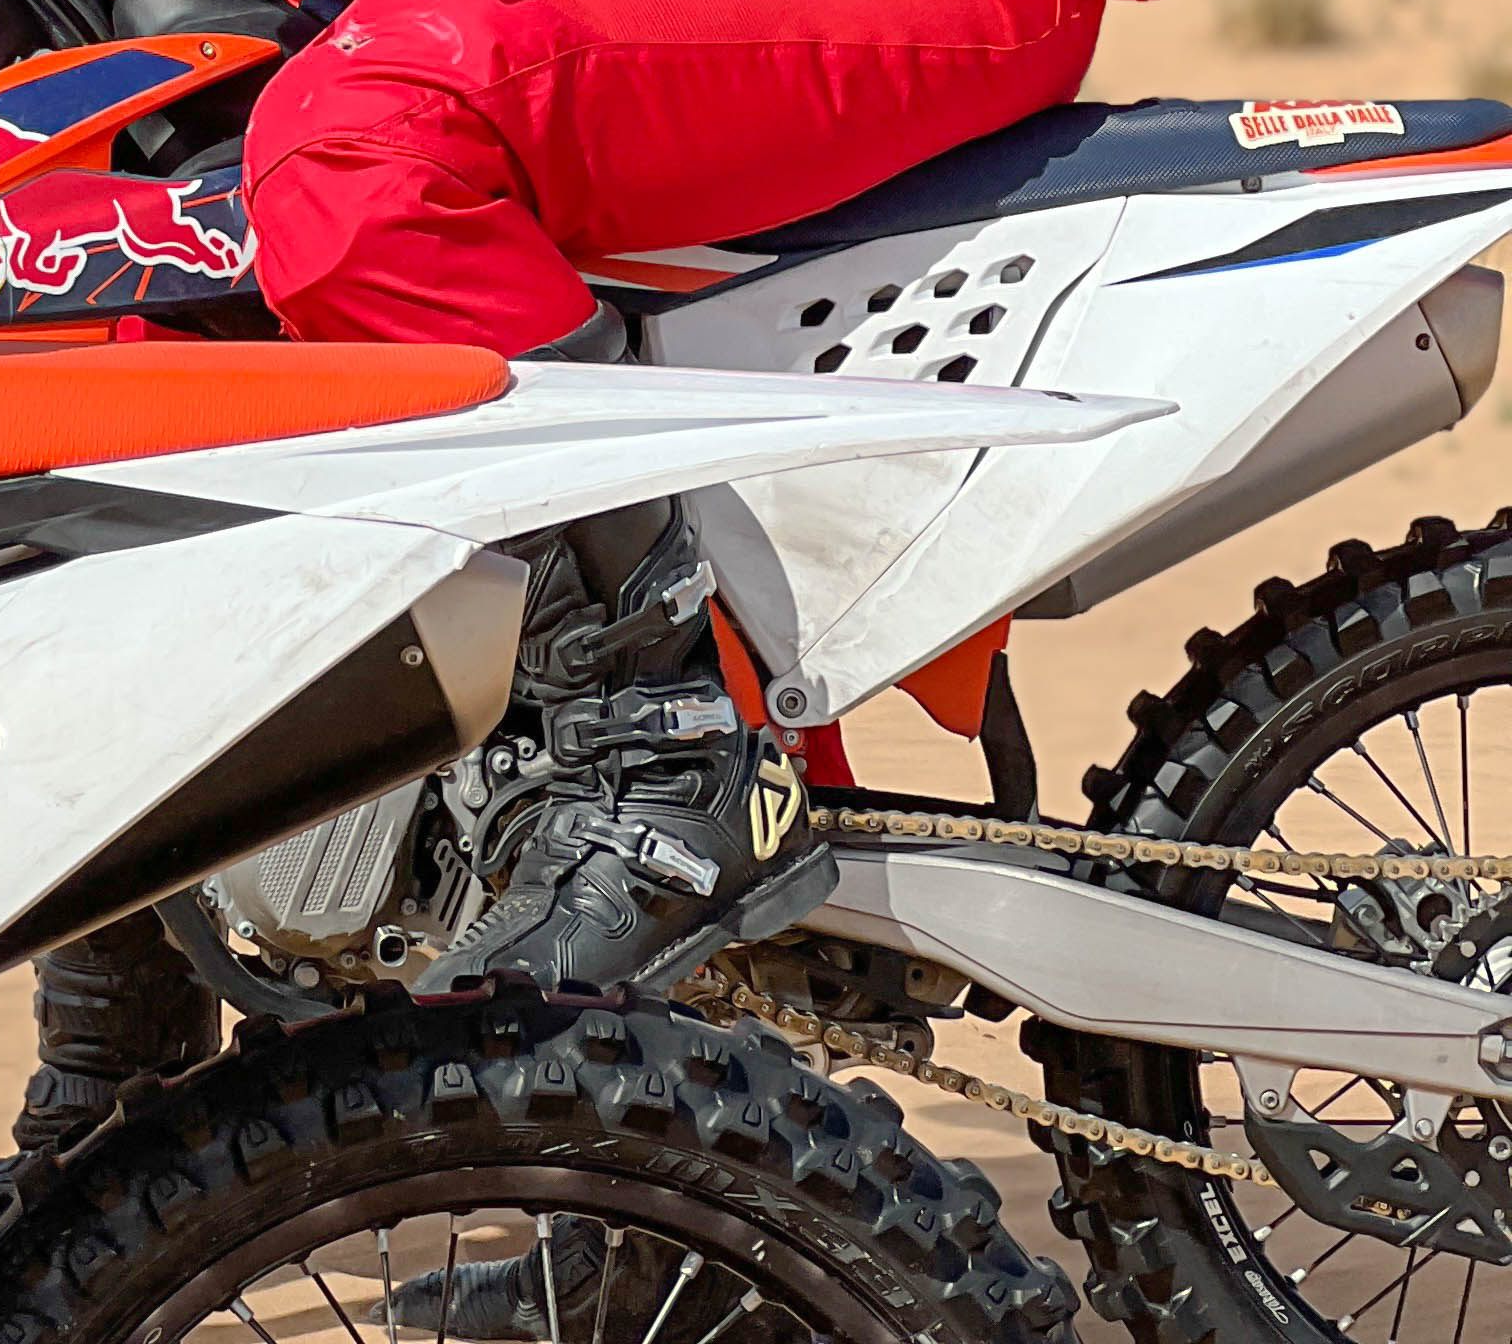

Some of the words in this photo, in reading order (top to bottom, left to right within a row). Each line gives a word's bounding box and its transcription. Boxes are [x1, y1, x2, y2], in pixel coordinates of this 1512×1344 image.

[1240, 115, 1288, 140] SELLE
[1292, 112, 1343, 130] DALLA
[1345, 105, 1394, 125] VALLE
[1199, 1181, 1248, 1265] EXCEL
